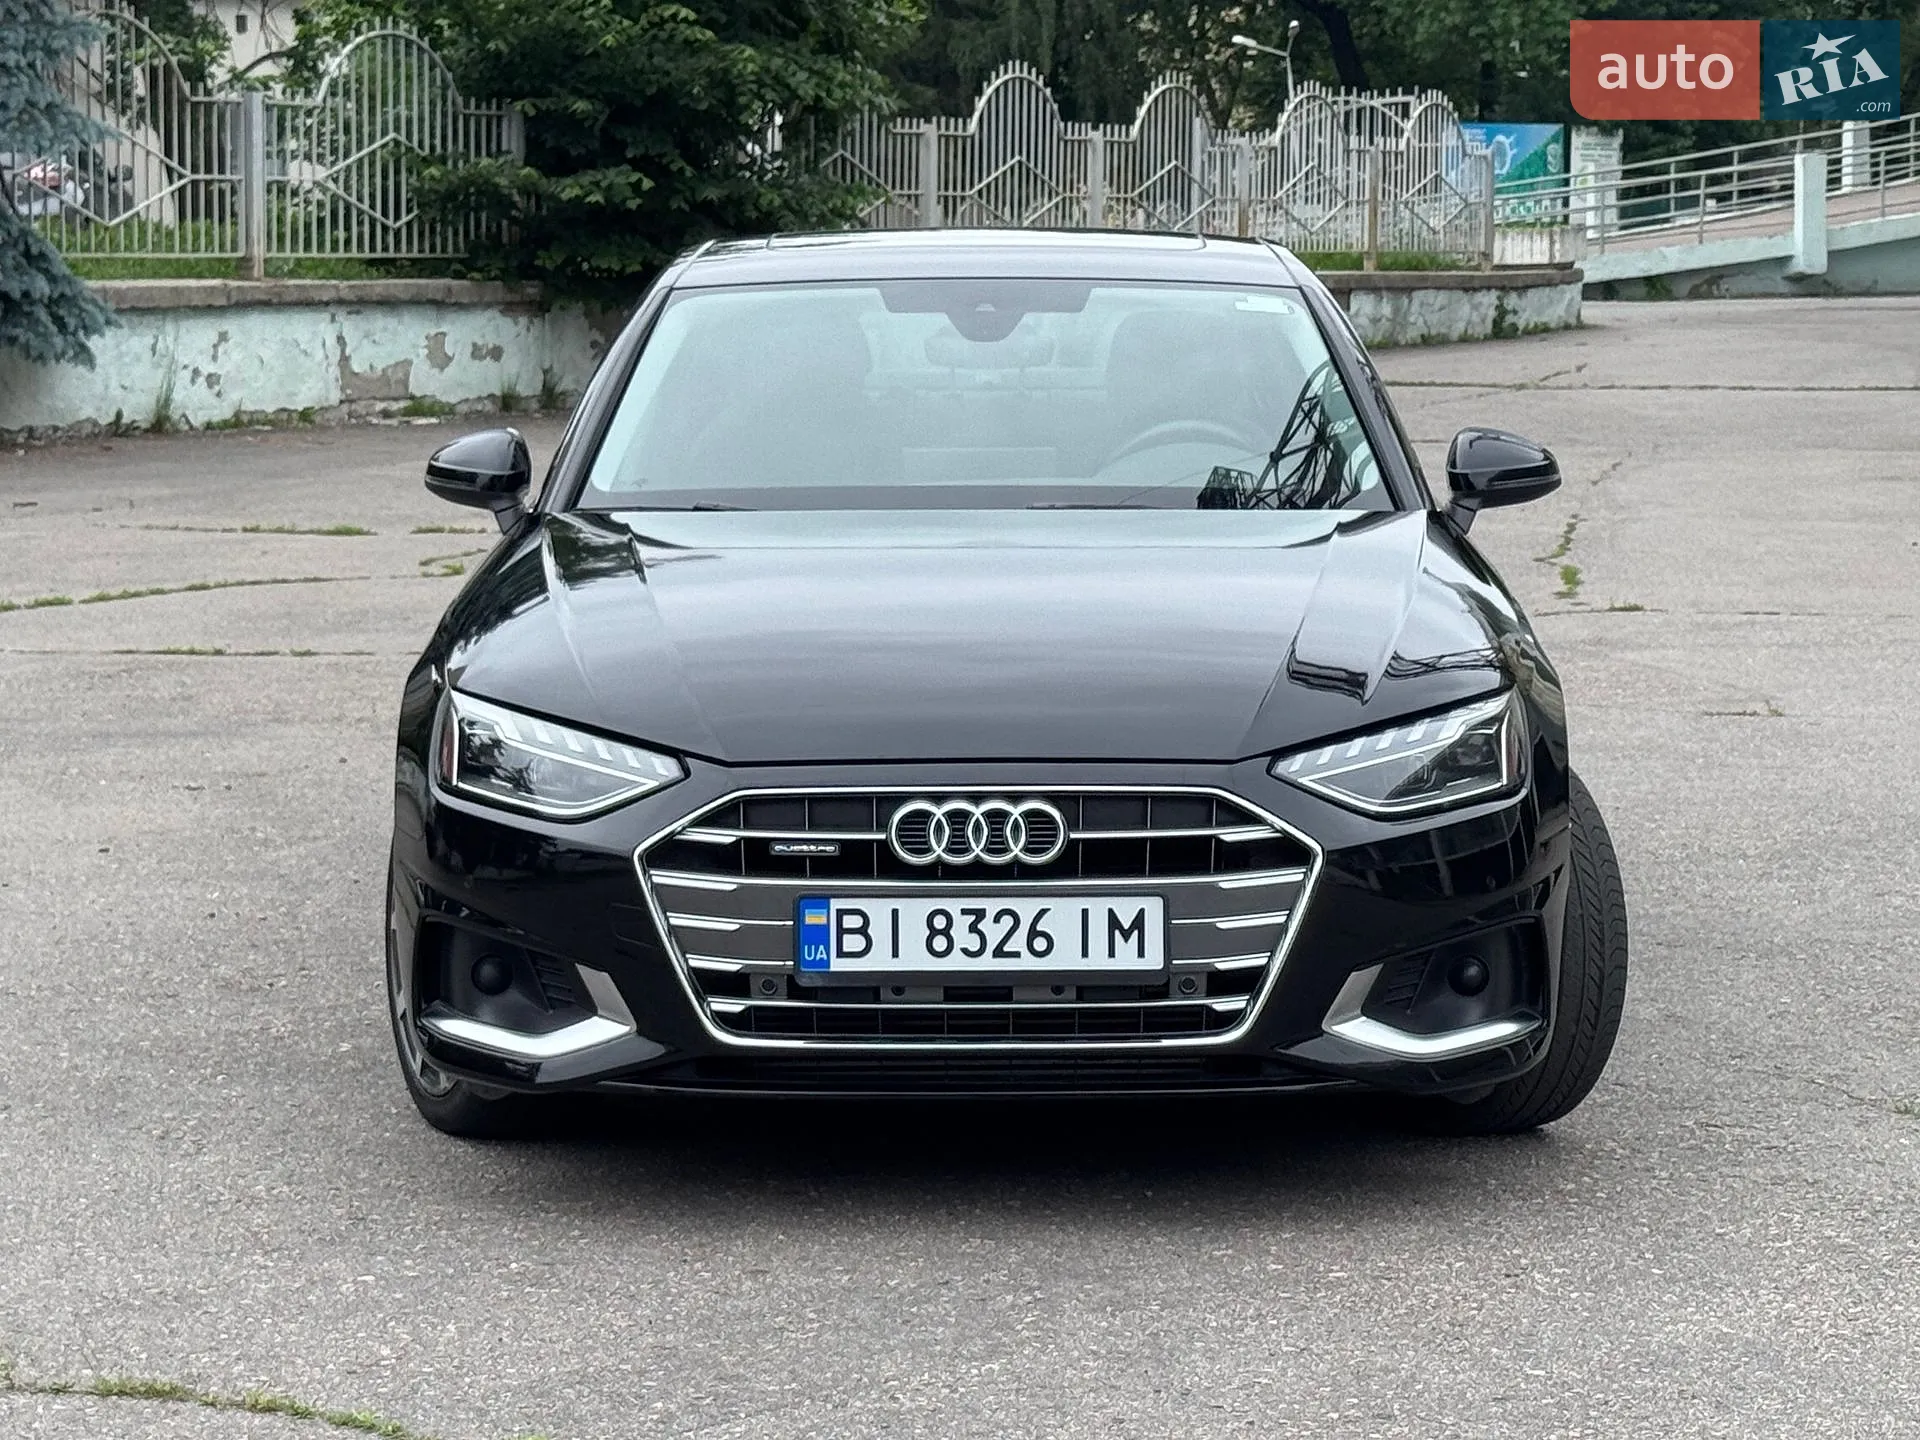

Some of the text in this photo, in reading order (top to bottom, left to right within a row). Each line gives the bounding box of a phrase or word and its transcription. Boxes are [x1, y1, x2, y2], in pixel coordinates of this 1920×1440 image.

[835, 907, 1146, 959] BI 8326 IM
[804, 944, 828, 961] UA
